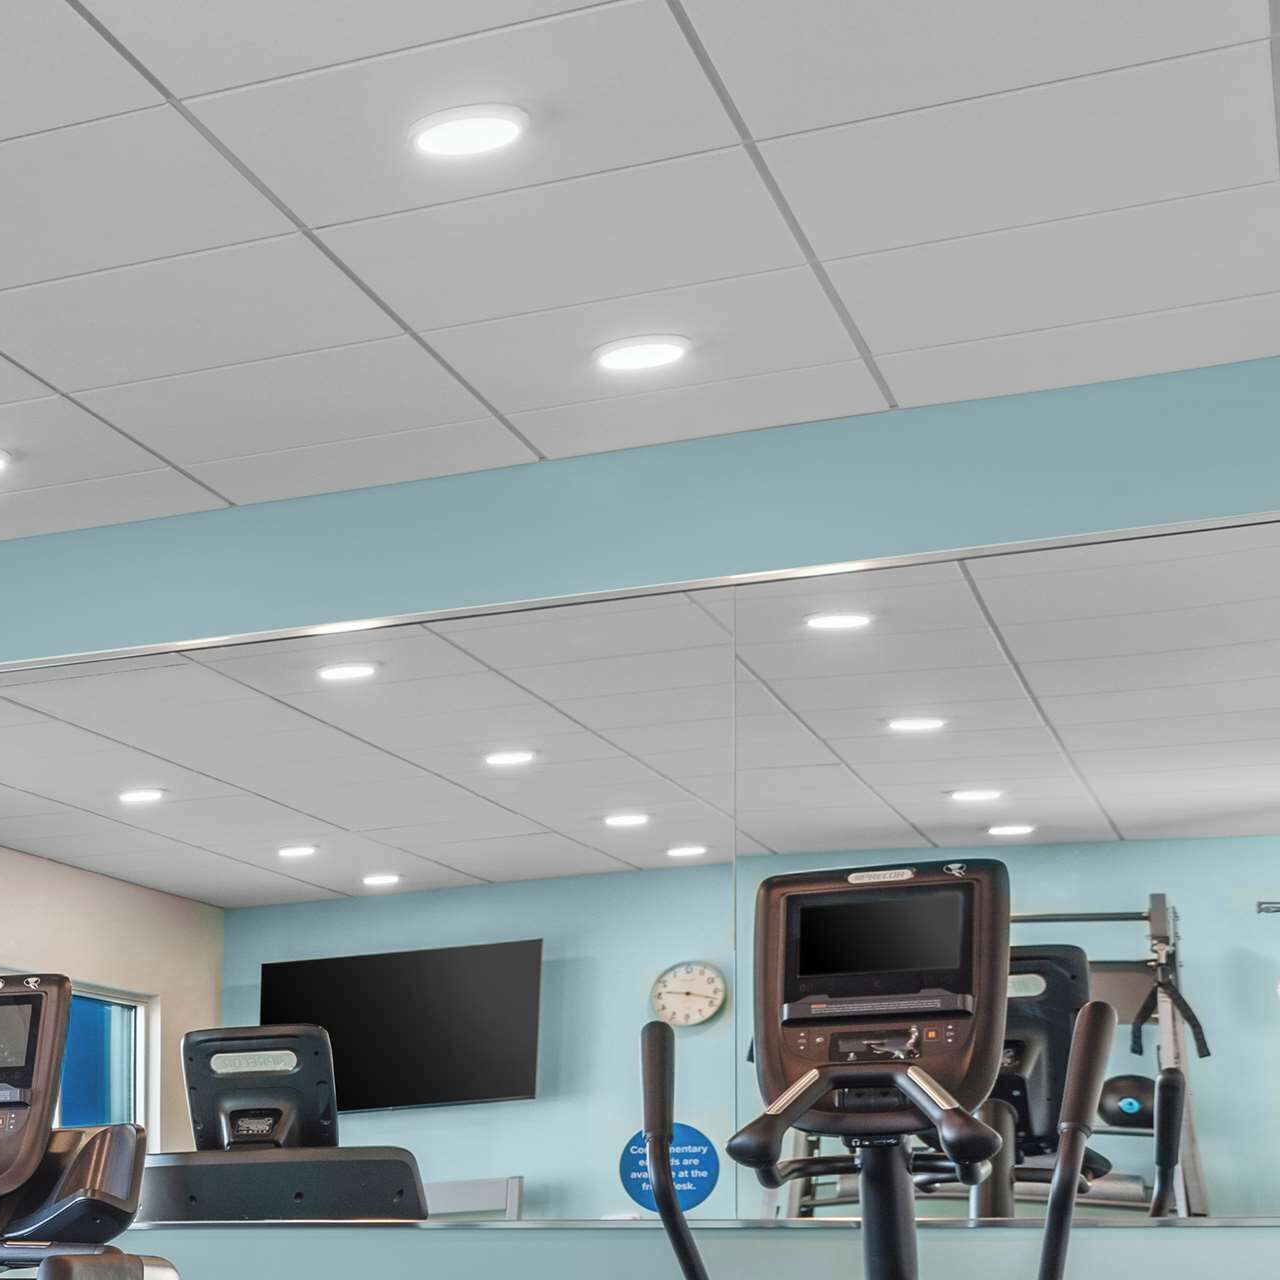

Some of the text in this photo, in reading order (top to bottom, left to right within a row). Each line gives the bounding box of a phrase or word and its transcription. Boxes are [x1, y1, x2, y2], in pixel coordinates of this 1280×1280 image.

[682, 1158, 700, 1166] are
[678, 1170, 689, 1178] at
[690, 1169, 709, 1178] the
